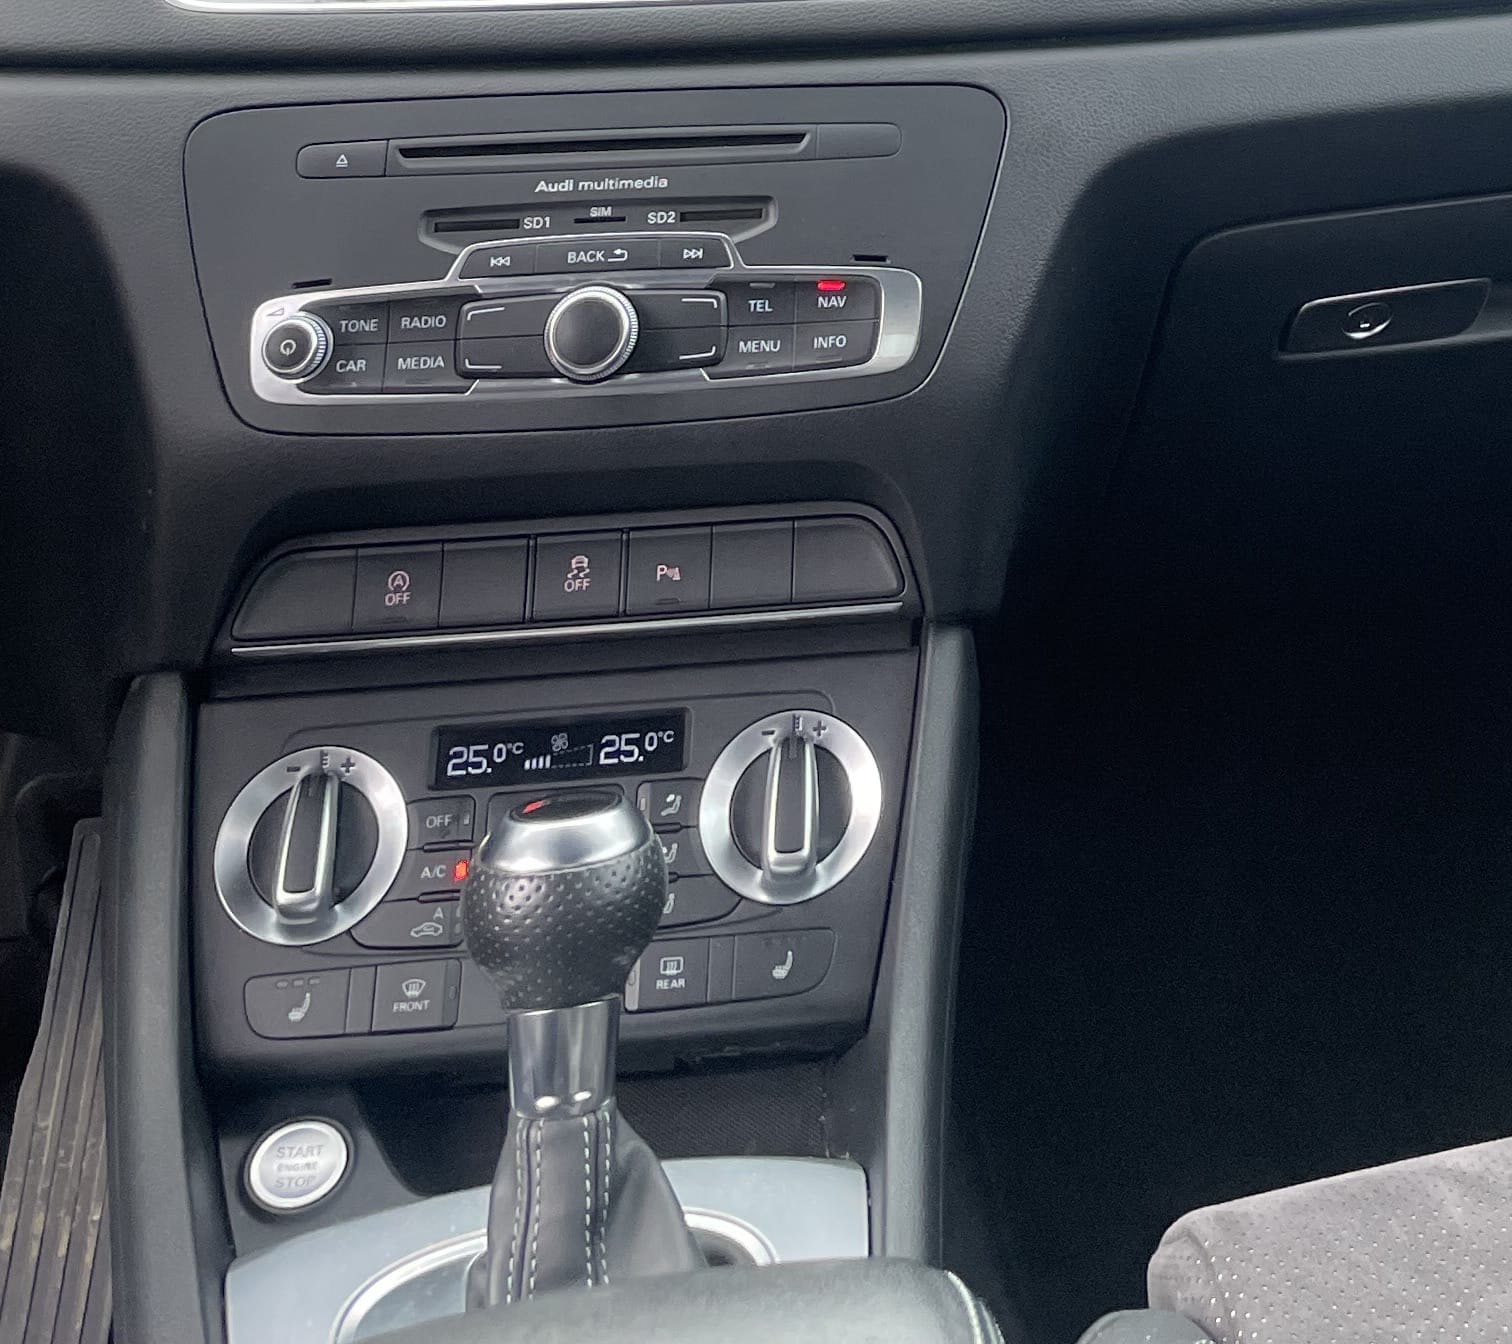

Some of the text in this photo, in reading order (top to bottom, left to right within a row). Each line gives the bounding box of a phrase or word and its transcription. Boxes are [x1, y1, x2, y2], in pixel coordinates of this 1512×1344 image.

[534, 175, 669, 193] Audi multimedia
[589, 206, 613, 218] SIM
[647, 211, 676, 224] SD2
[523, 216, 551, 230] SD1
[567, 249, 606, 264] BACK
[748, 299, 773, 313] TEL
[817, 295, 848, 309] NAV
[340, 318, 380, 333] TONE
[400, 314, 447, 329] RADIO
[738, 339, 781, 354] MENU
[813, 334, 847, 349] INFO
[335, 359, 367, 373] CAR
[397, 355, 445, 370] MEDIA
[563, 577, 591, 593] OFF
[384, 591, 411, 607] OFF
[425, 813, 453, 829] OFF
[420, 864, 447, 879] A/C
[655, 977, 686, 990] REAR
[392, 999, 431, 1013] FRONT
[275, 1144, 325, 1159] START
[275, 1161, 318, 1173] ENGINE
[274, 1175, 317, 1189] STOP
